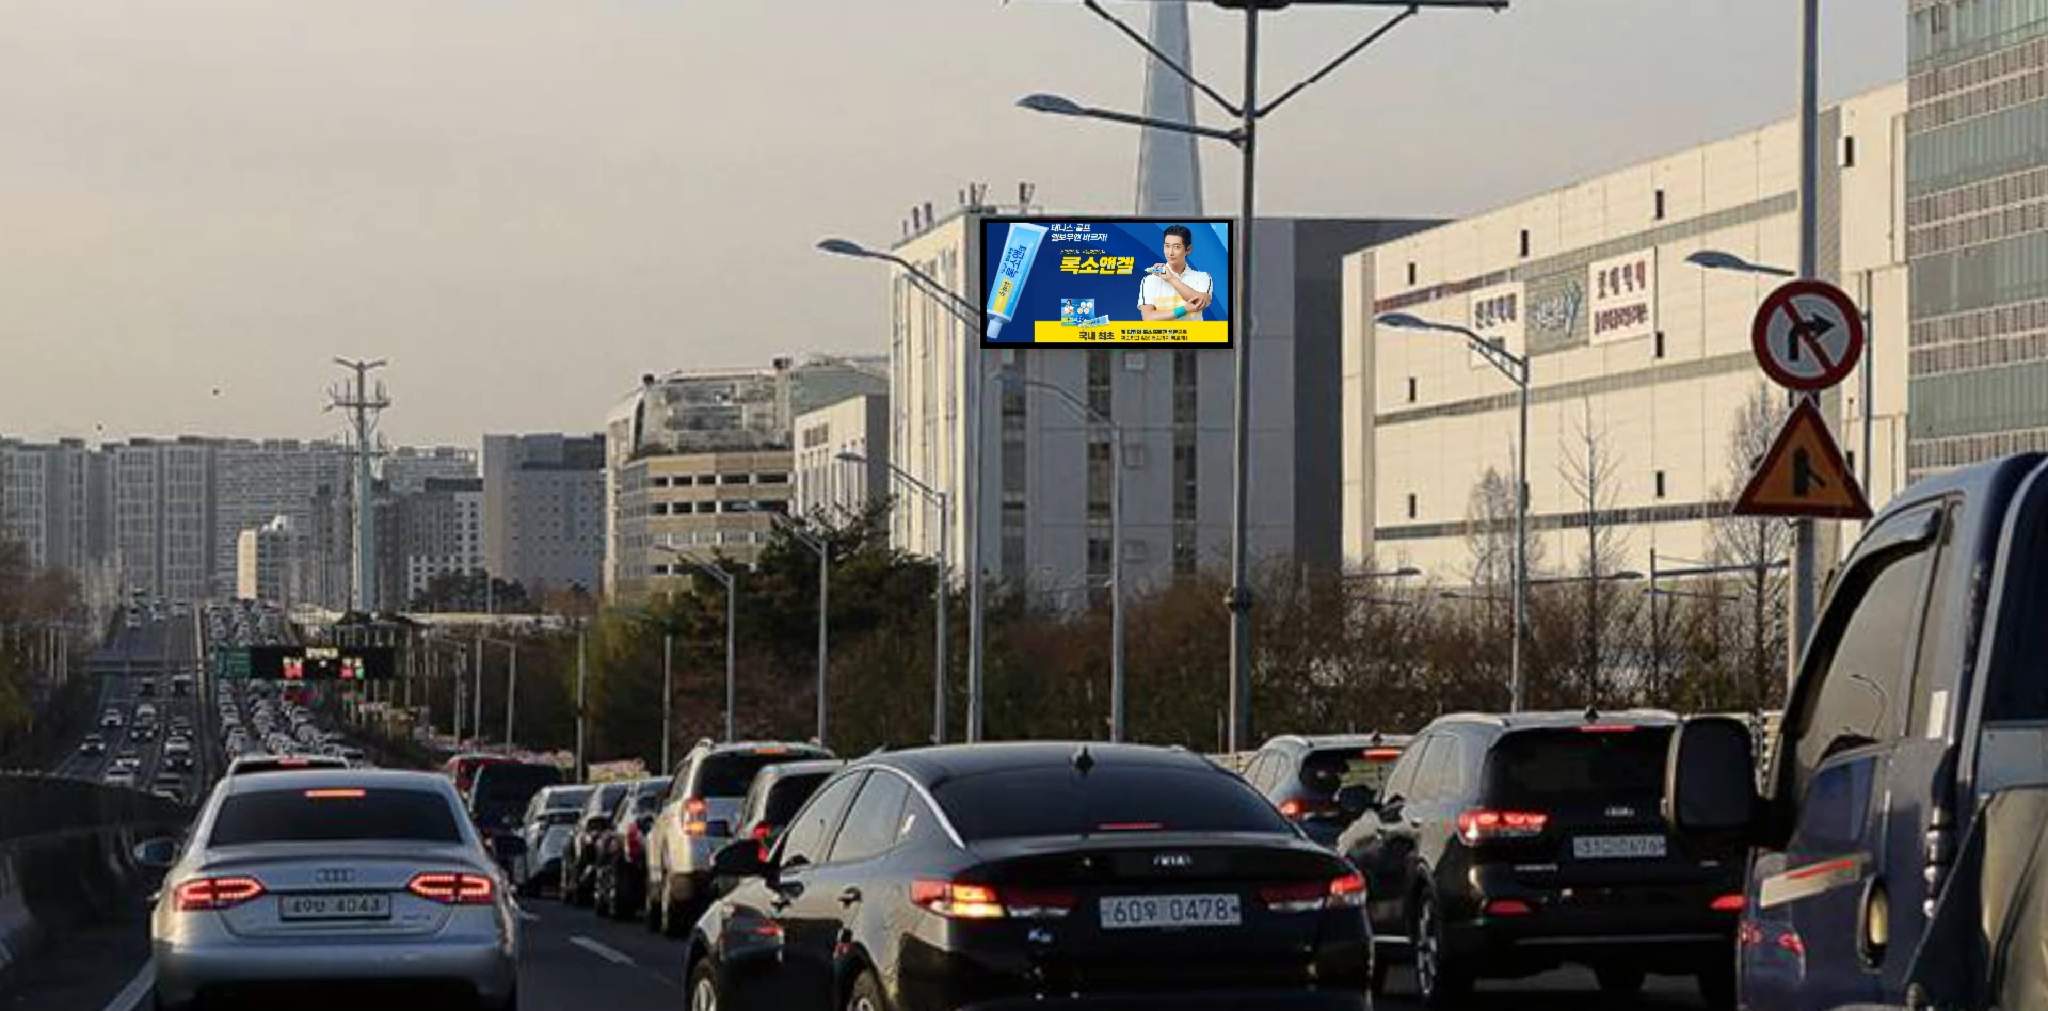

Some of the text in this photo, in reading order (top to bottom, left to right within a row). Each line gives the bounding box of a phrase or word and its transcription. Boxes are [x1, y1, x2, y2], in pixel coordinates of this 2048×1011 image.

[1060, 256, 1135, 275] 록소앤겔
[1078, 331, 1096, 341] 국내
[1098, 331, 1115, 341] 최초
[1169, 898, 1230, 922] 0478
